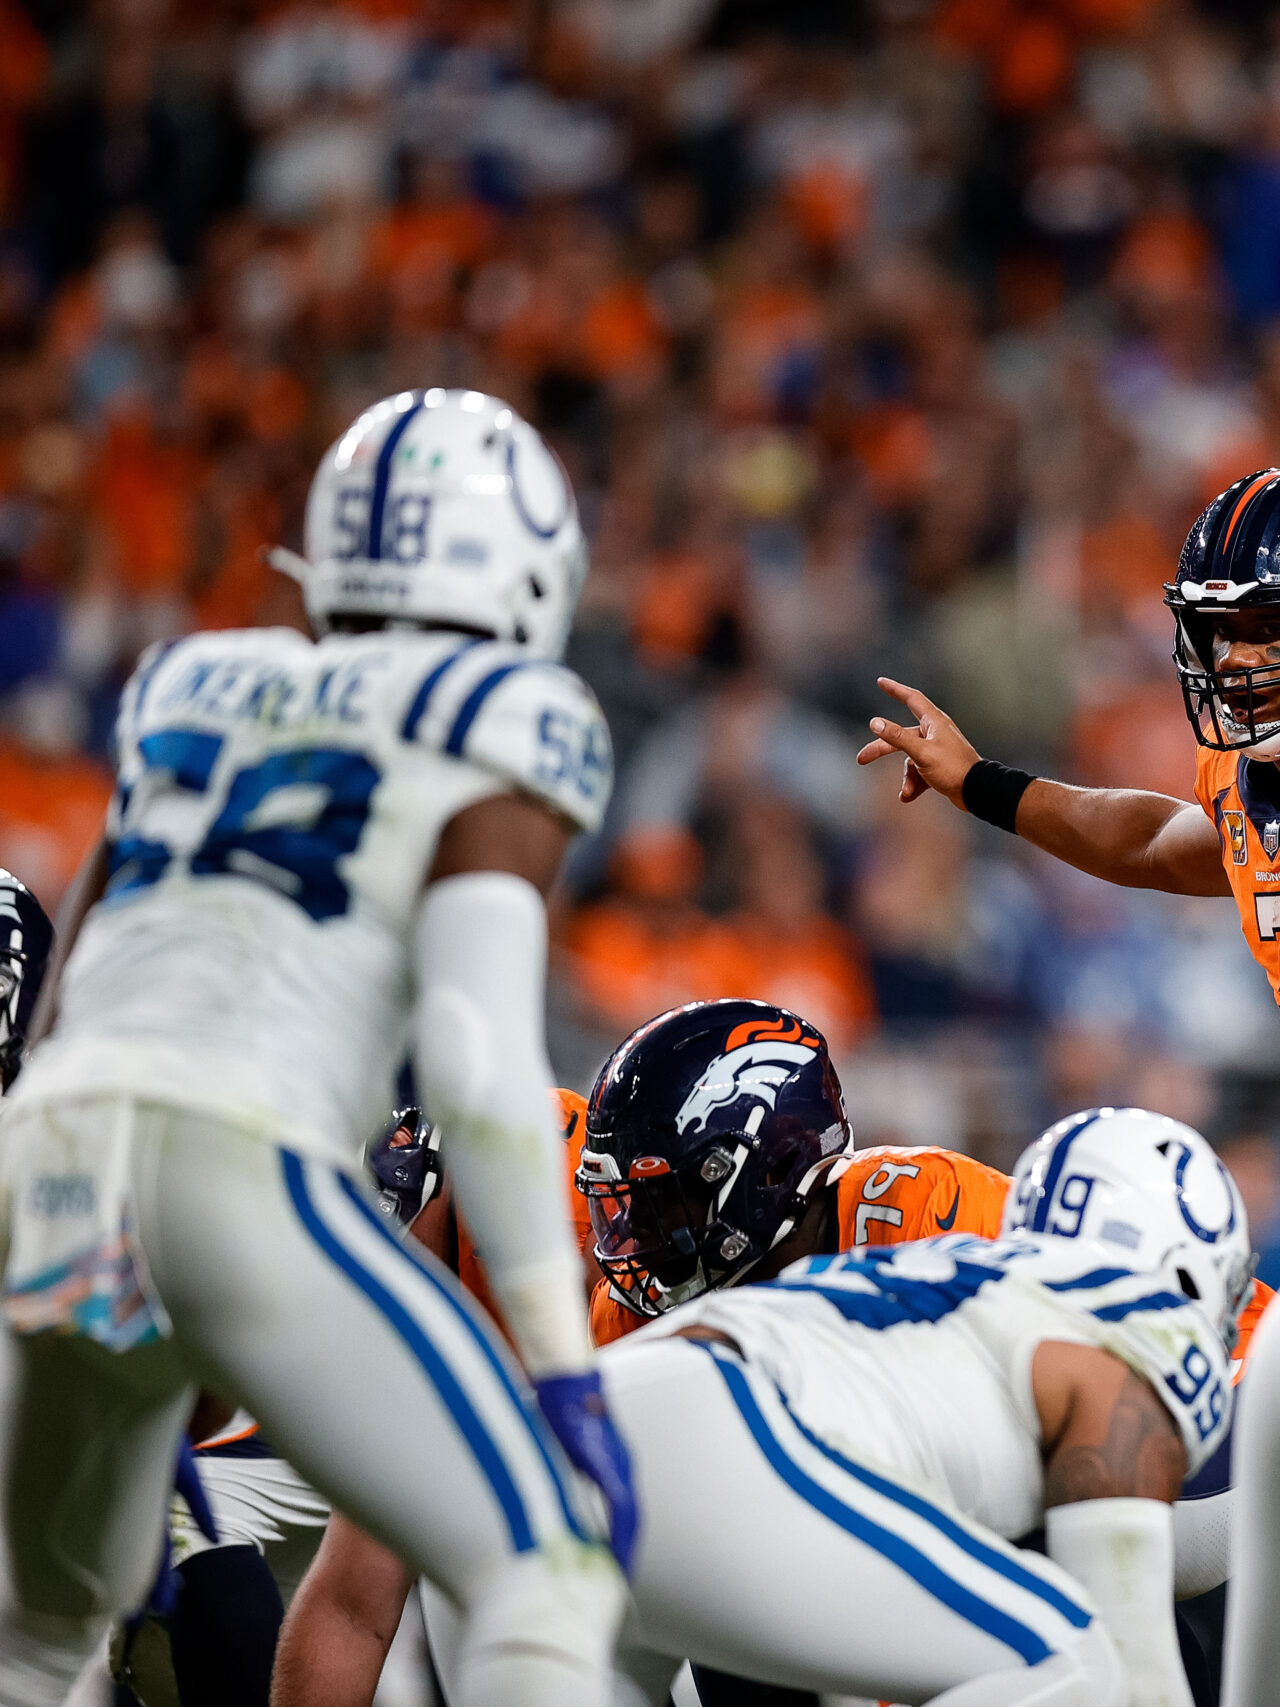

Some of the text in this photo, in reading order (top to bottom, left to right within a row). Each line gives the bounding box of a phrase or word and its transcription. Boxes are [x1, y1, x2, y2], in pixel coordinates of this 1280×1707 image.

[332, 486, 434, 567] 58
[1205, 582, 1228, 590] BRONCOS
[854, 1160, 921, 1246] 79
[1162, 1343, 1227, 1442] 99
